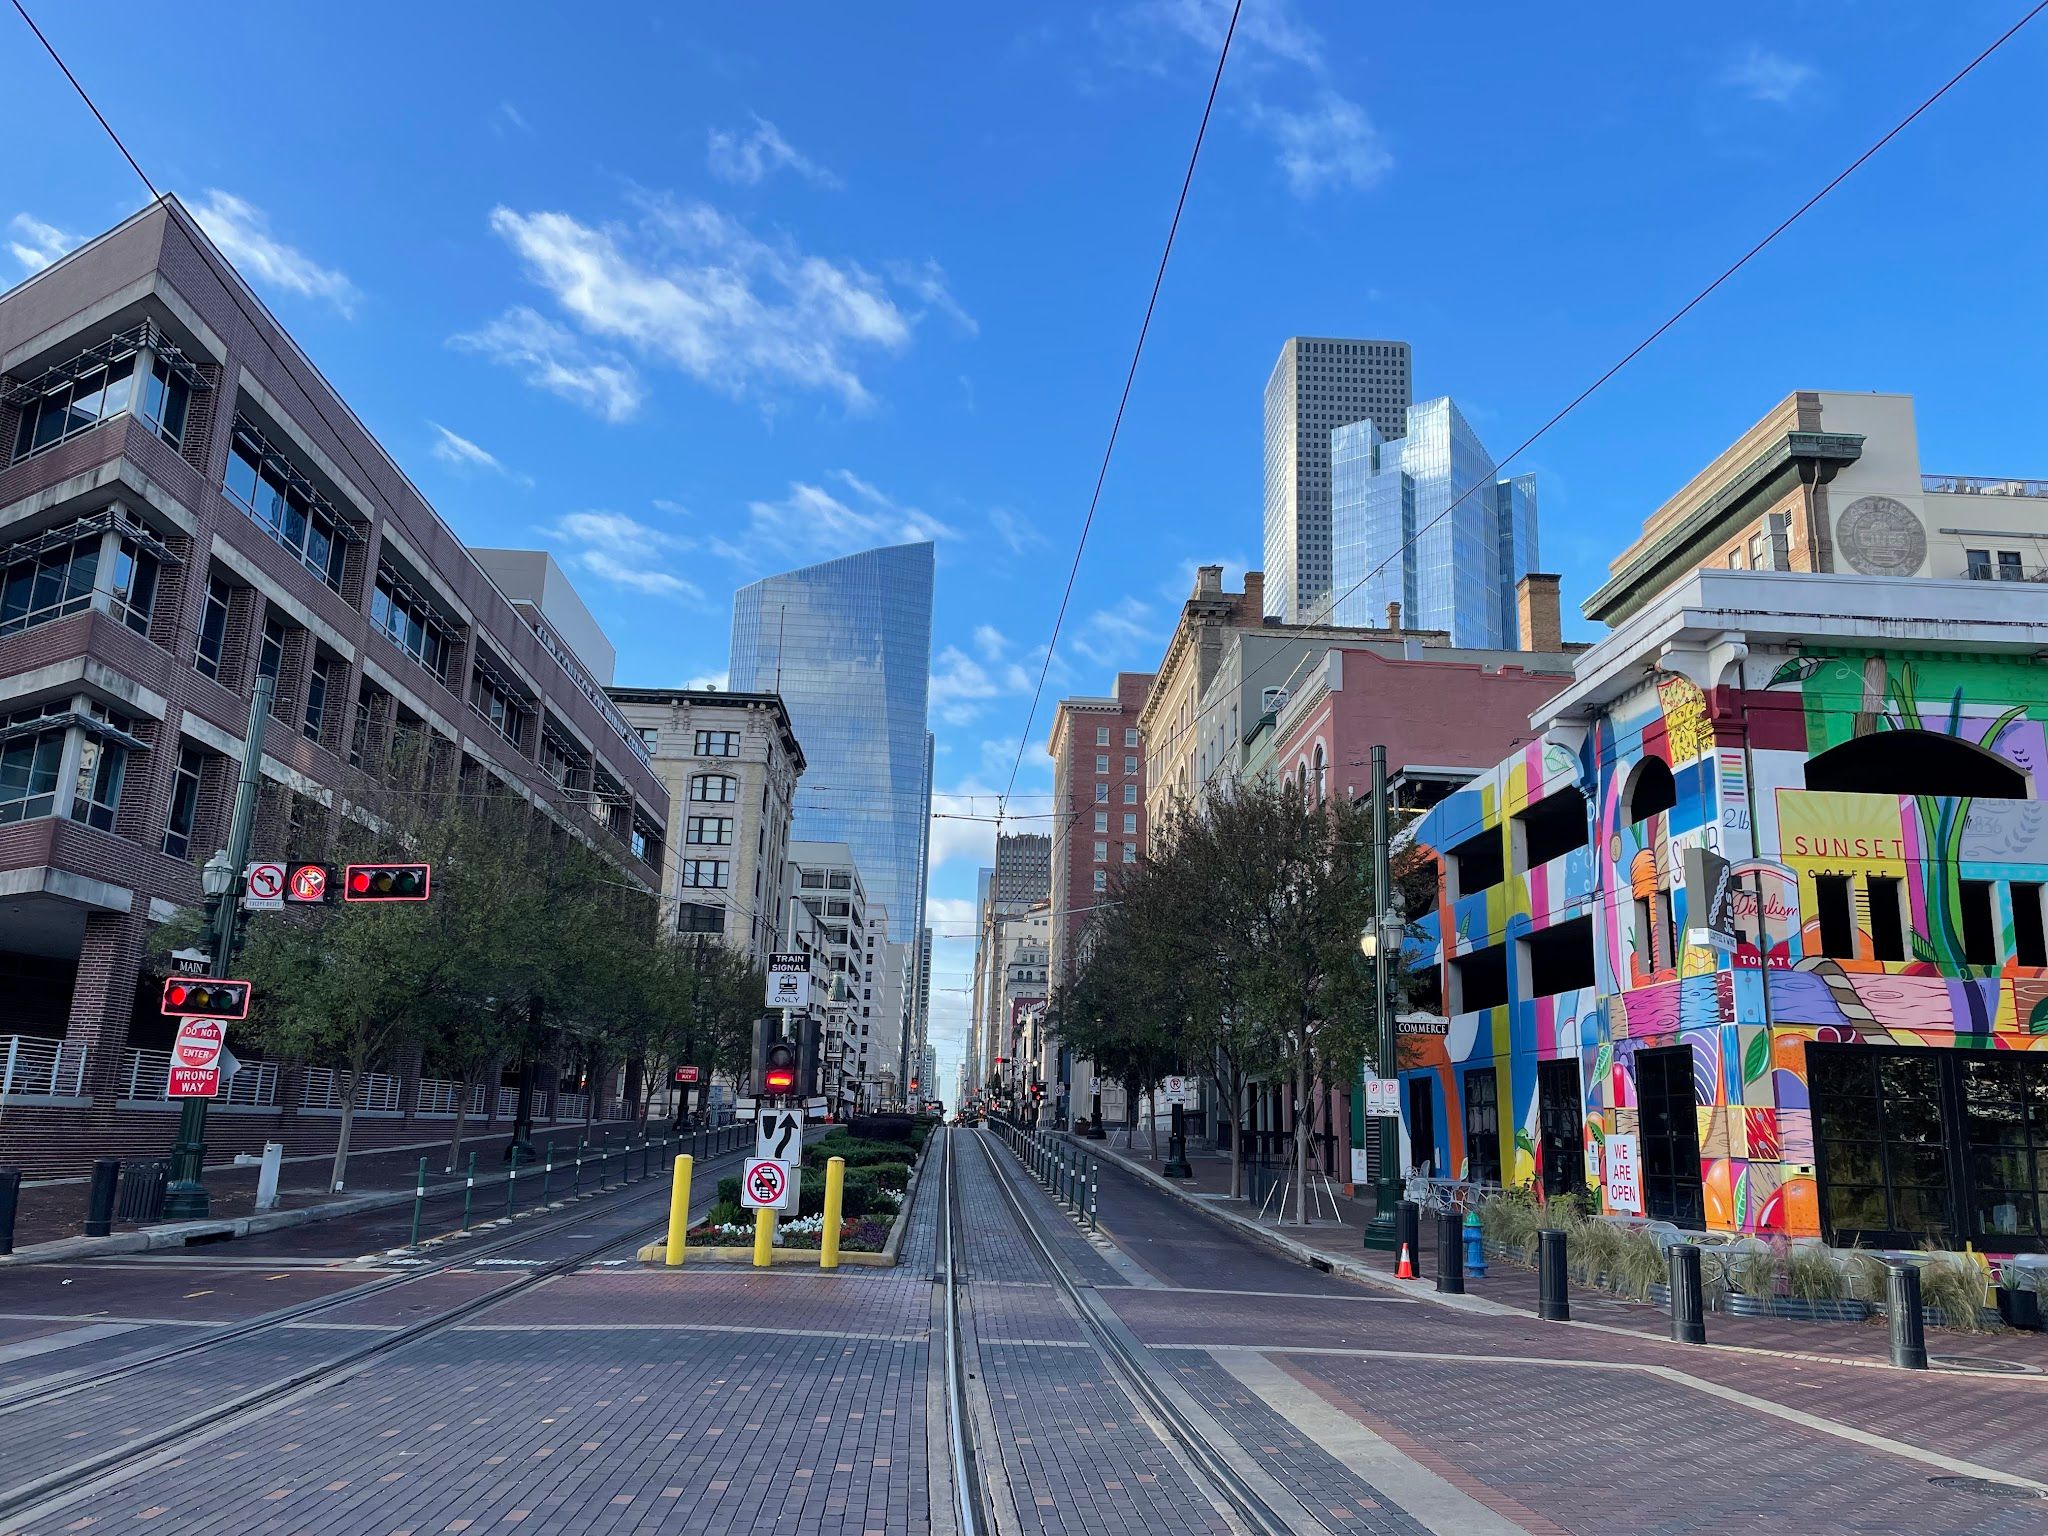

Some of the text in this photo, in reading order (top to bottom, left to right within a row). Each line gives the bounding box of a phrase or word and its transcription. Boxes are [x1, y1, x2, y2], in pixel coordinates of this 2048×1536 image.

[1795, 836, 1902, 860] SUNSET
[775, 955, 804, 963] TRAIN
[179, 960, 203, 974] MAIN
[771, 964, 807, 972] SIGNAL
[185, 1026, 218, 1038] DO NOT
[1398, 1023, 1446, 1034] COMMERCE
[182, 1048, 209, 1059] ENTER
[175, 1070, 213, 1081] WRONG
[181, 1082, 205, 1092] WAY
[1614, 1144, 1628, 1159] WE
[1613, 1164, 1632, 1181] ARE
[1611, 1184, 1636, 1202] OPEN
